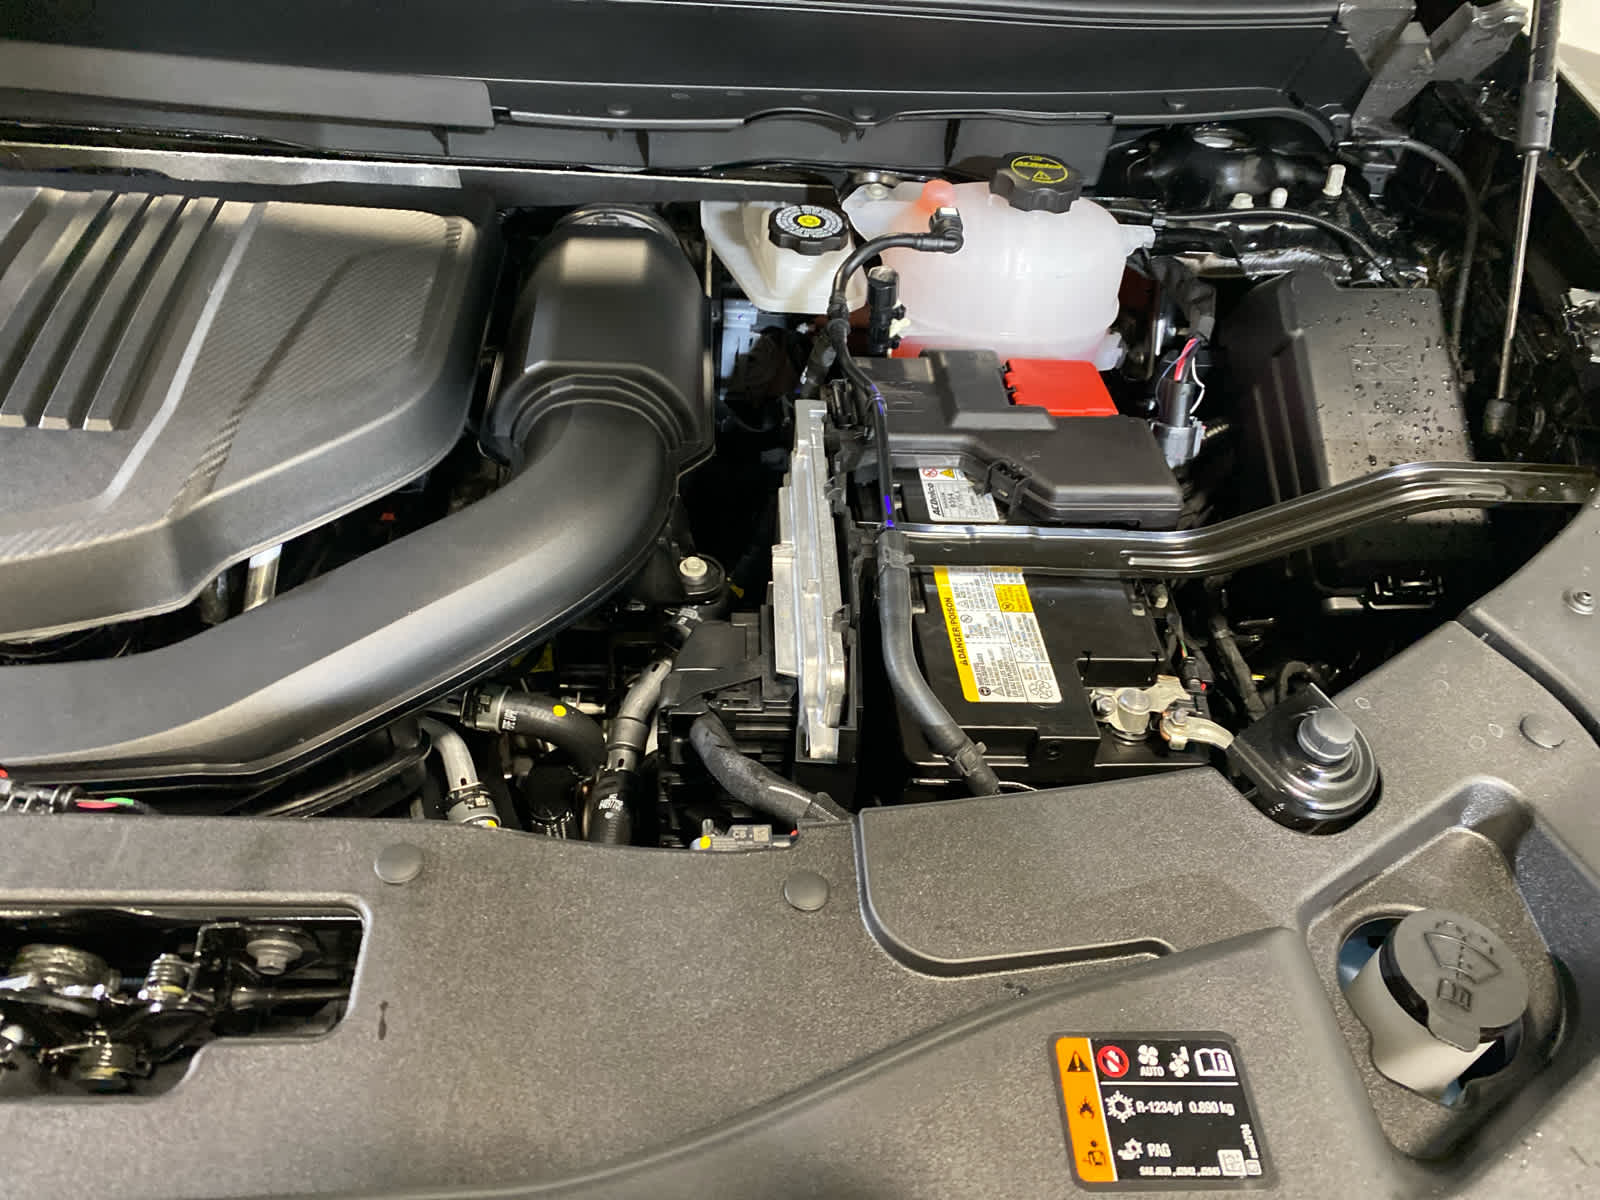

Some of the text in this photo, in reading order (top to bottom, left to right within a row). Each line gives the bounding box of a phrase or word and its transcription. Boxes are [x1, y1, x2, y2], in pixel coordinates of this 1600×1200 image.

[1140, 1065, 1165, 1077] AUTO
[1219, 1101, 1235, 1116] kg
[1147, 1143, 1172, 1157] PAG
